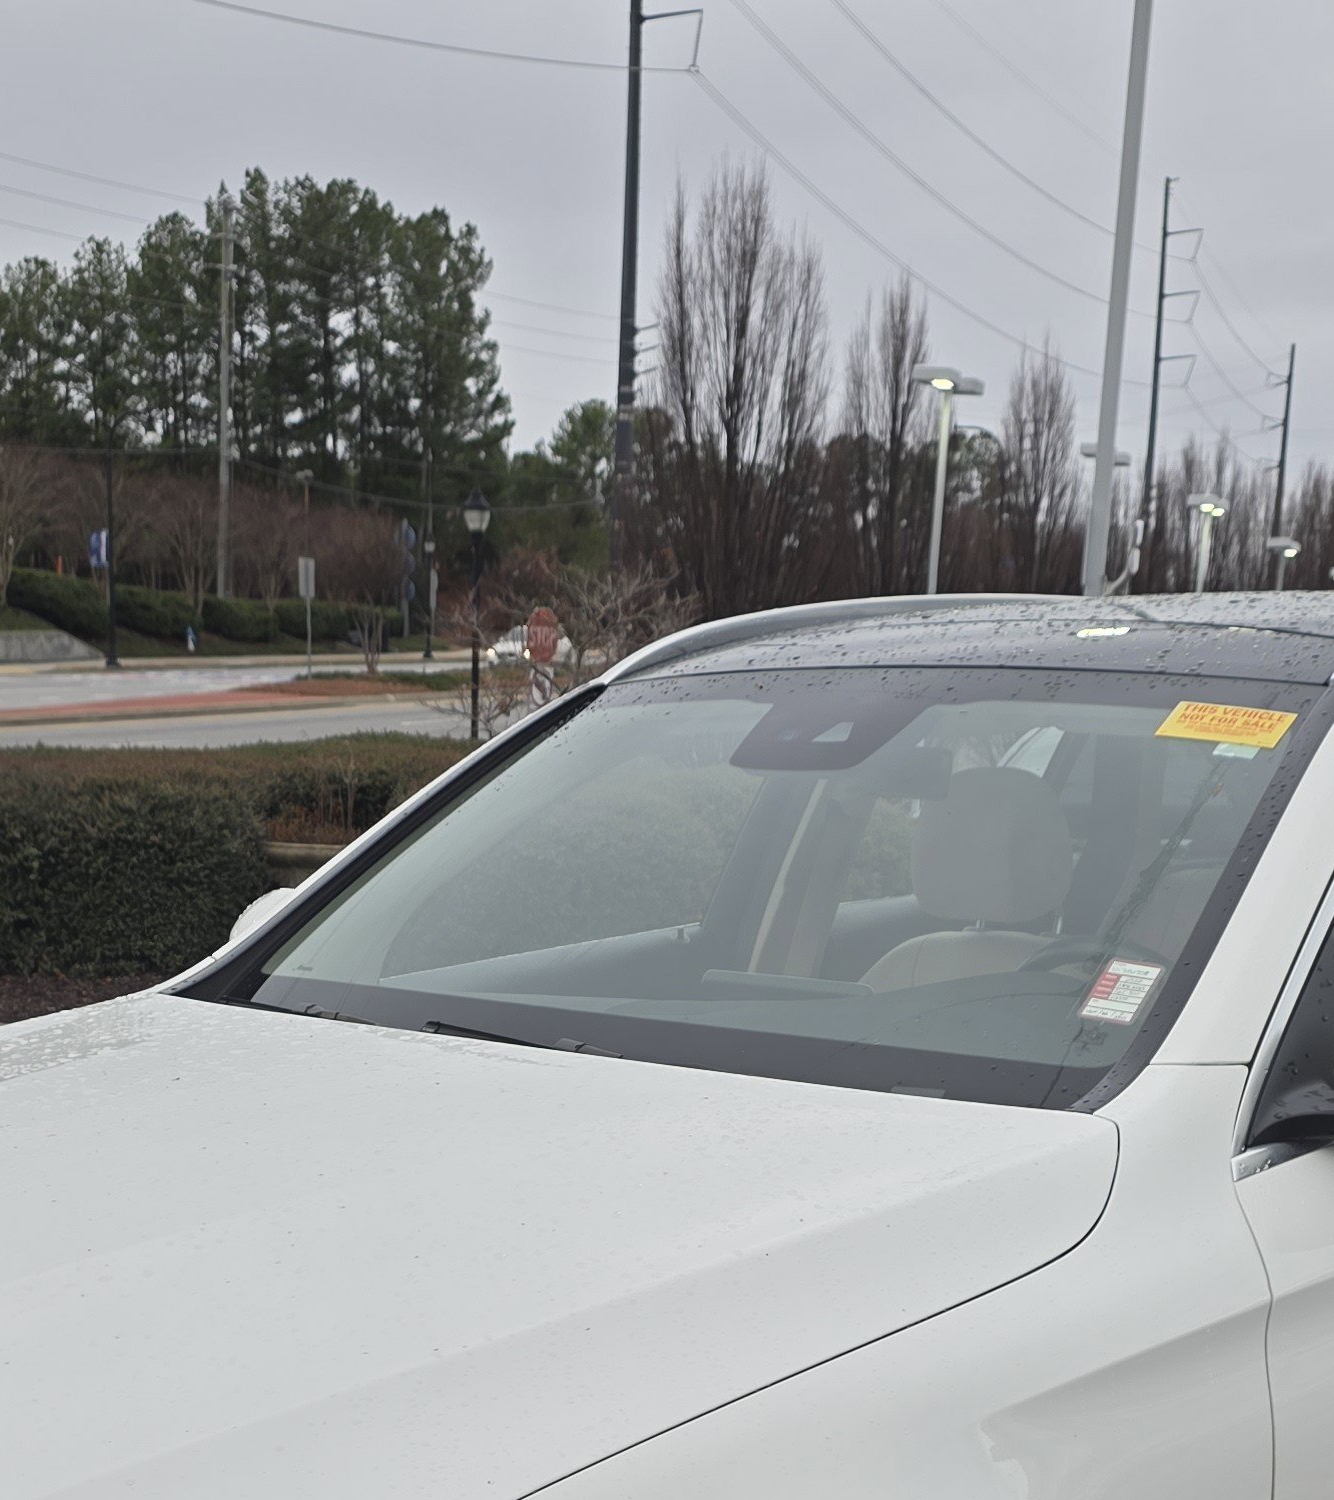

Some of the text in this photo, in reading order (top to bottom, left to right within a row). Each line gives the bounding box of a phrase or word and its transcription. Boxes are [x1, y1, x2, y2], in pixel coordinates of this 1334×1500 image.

[1183, 703, 1287, 722] THIS VEHICLE
[1179, 713, 1205, 721] NOT
[1210, 715, 1238, 725] FOR
[1242, 720, 1276, 731] SALE
